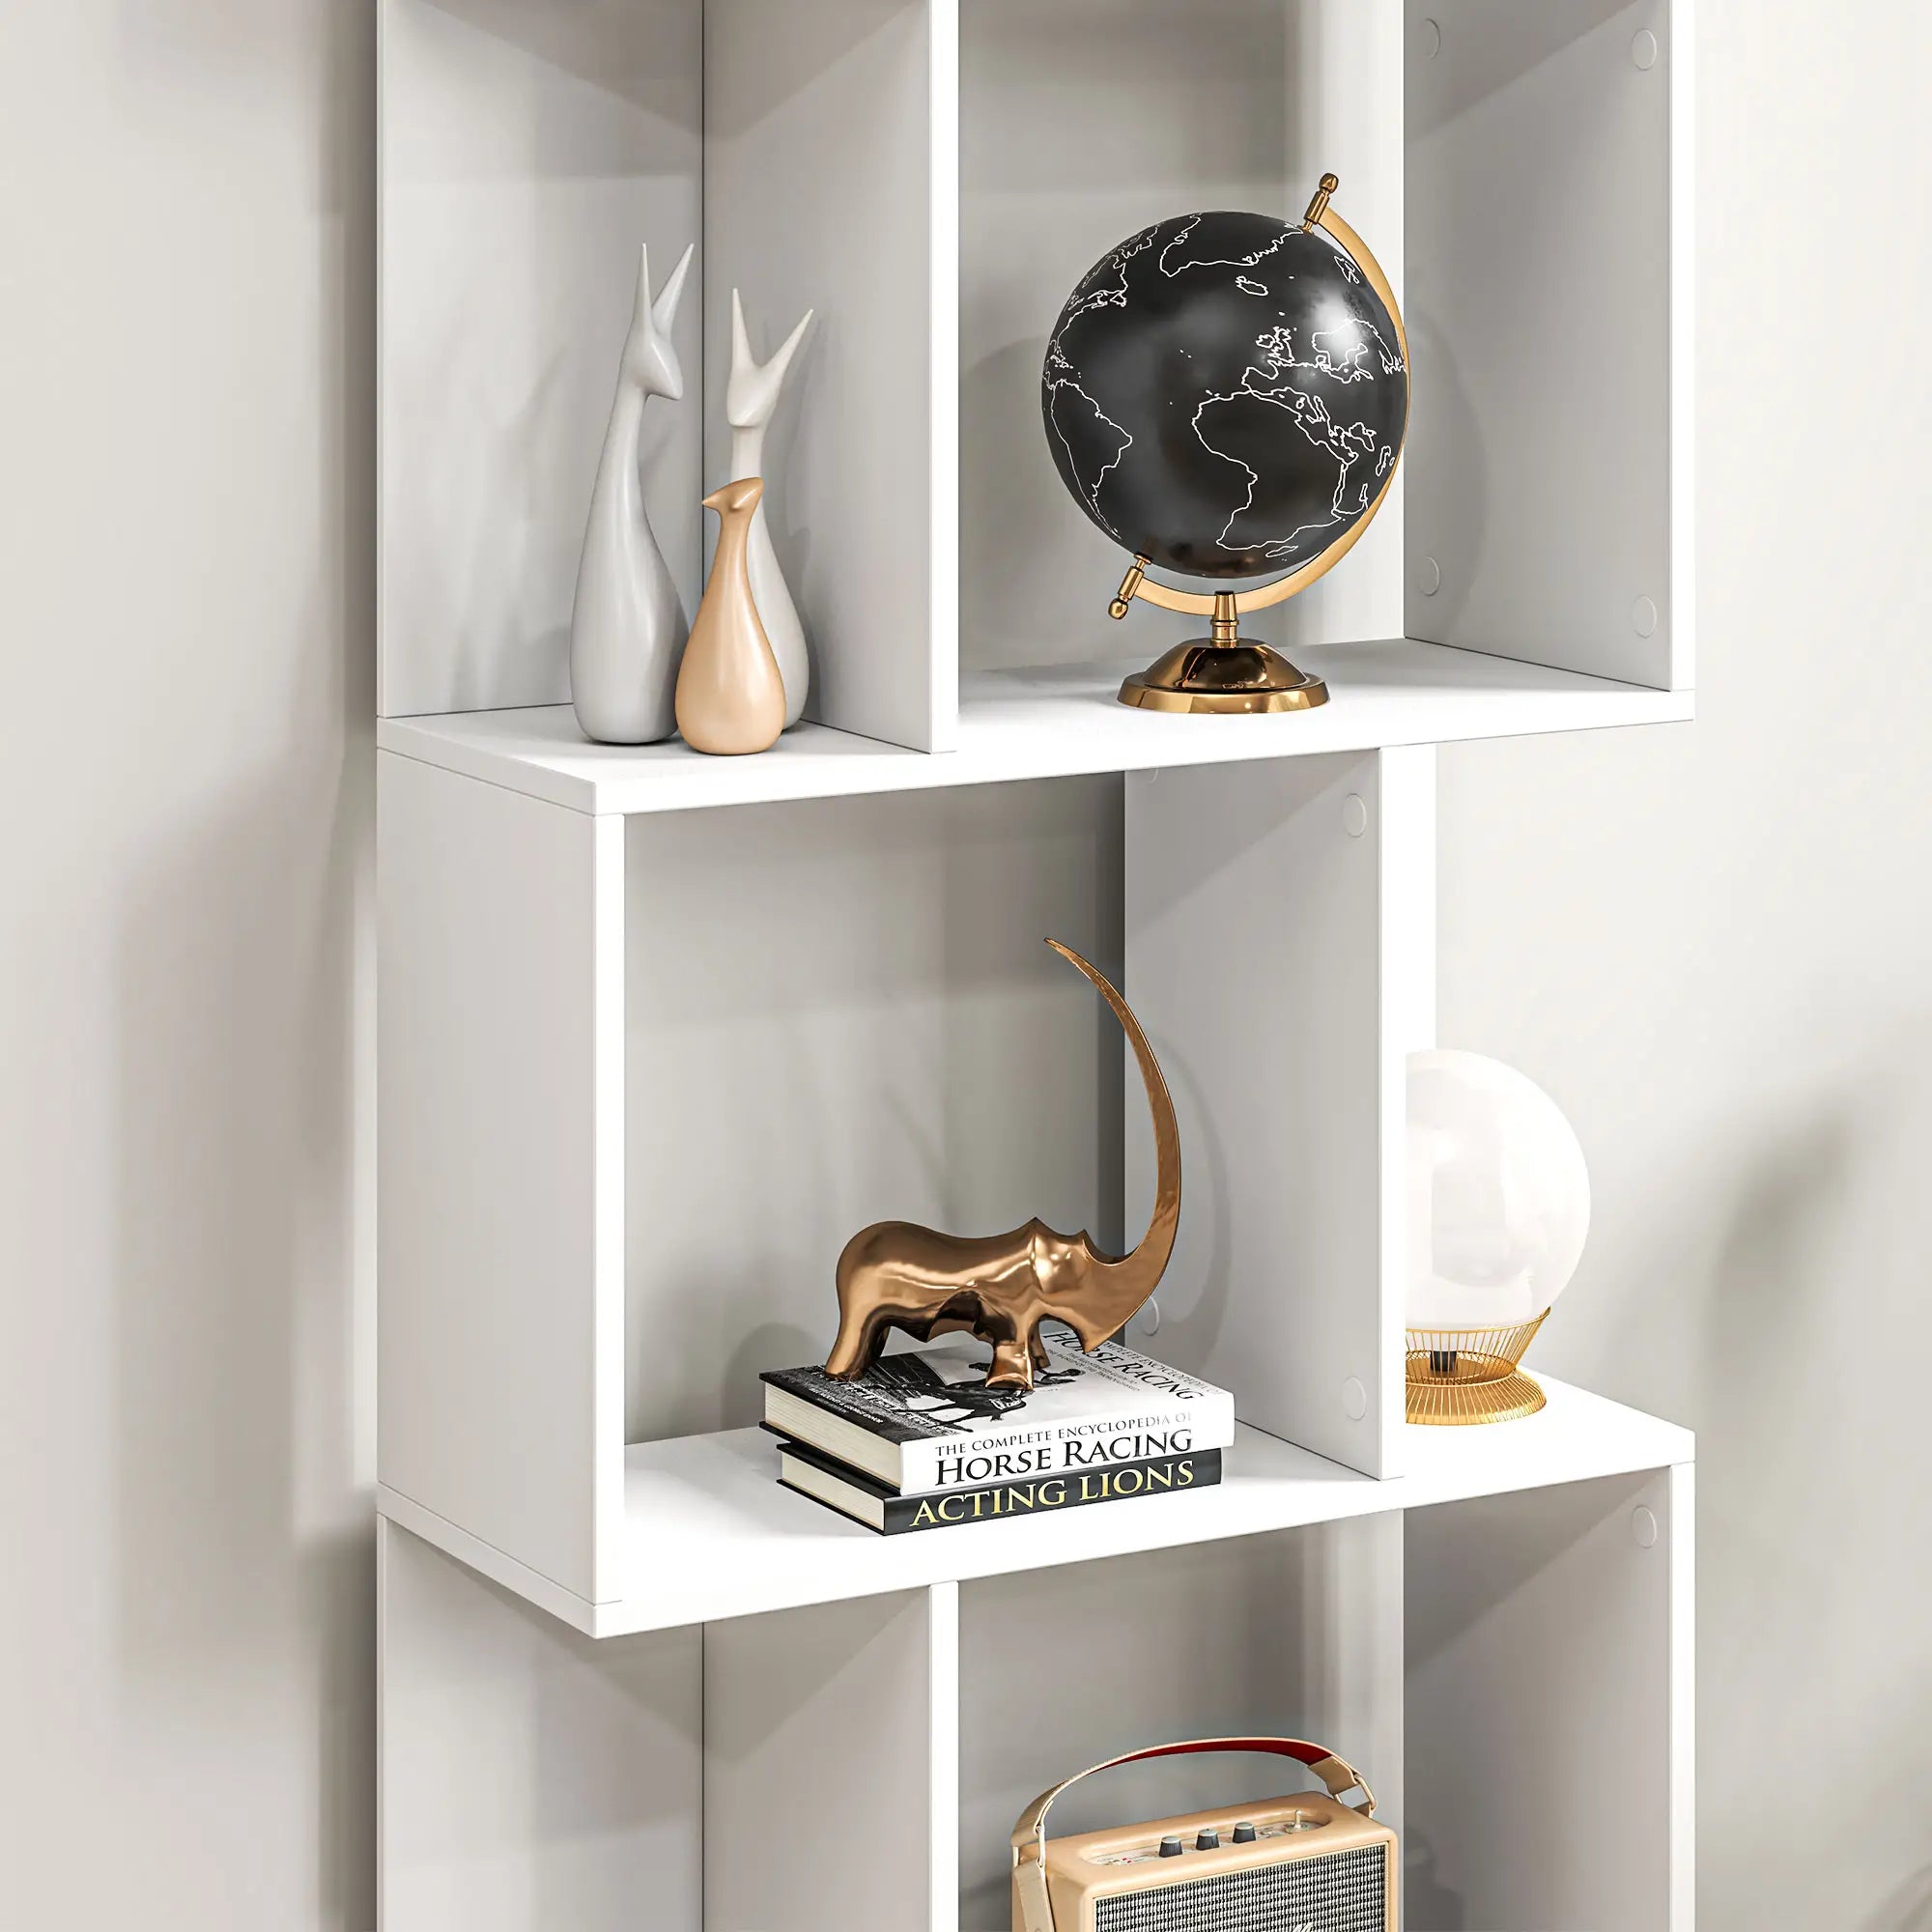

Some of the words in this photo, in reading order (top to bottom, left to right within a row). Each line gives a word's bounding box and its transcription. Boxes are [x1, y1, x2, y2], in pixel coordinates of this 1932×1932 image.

[1113, 1362, 1205, 1400] RACING
[934, 1442, 966, 1457] THE
[972, 1431, 1052, 1451] COMPLETE
[1058, 1414, 1170, 1438] ENCYCLOPEDIA
[935, 1447, 1051, 1487] HORSE
[1063, 1429, 1192, 1467] RACING
[909, 1479, 1066, 1526] ACTING
[1078, 1460, 1195, 1501] LIONS
